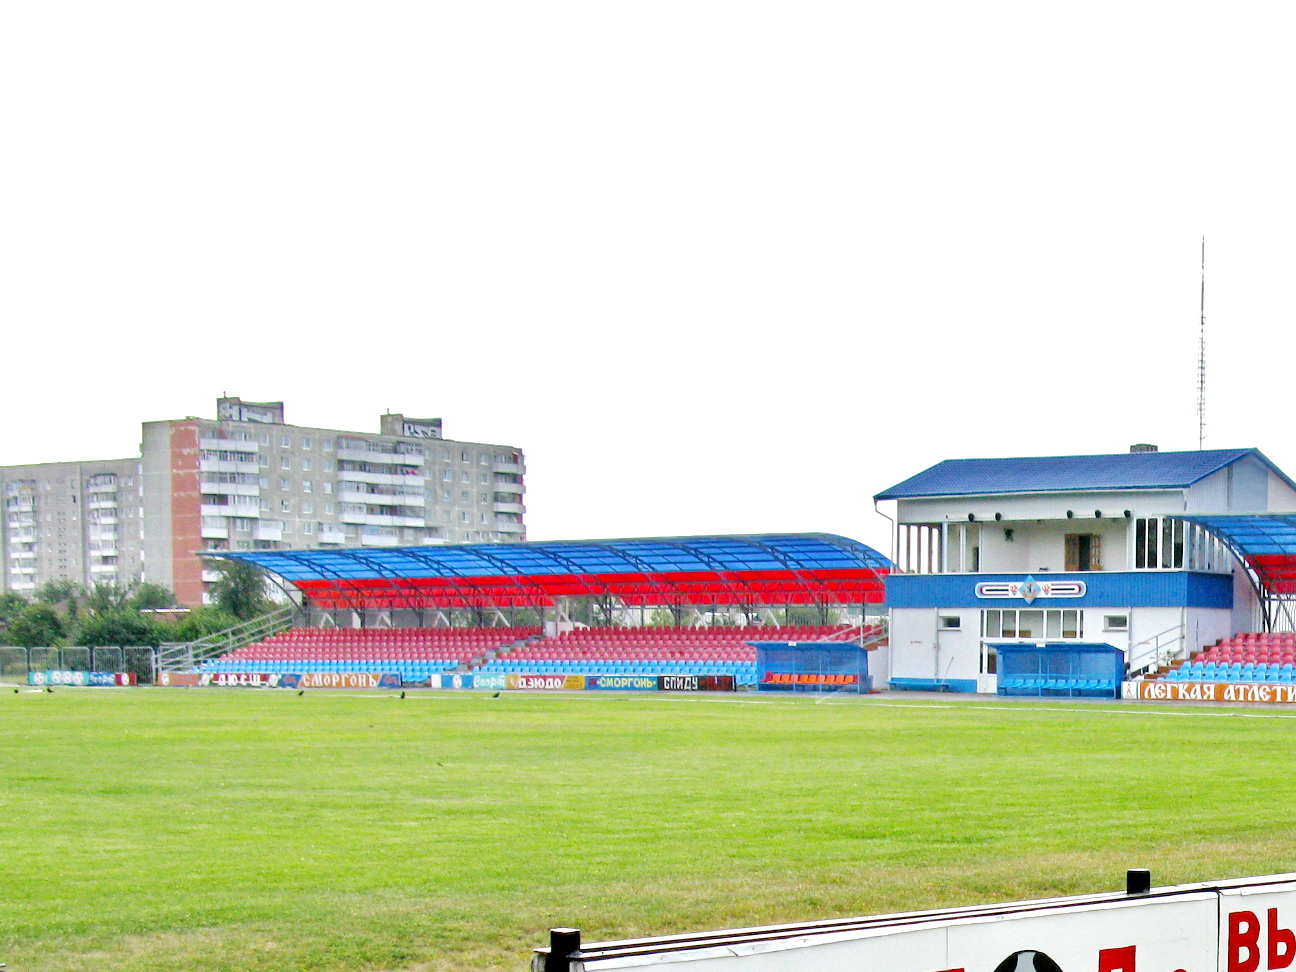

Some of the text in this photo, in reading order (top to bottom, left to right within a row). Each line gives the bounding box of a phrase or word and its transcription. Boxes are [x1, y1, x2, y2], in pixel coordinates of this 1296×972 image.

[519, 677, 562, 690] ДЗЮДО
[599, 677, 655, 689] СМОРГОНЬ
[664, 677, 699, 690] СПИДУ
[1144, 683, 1216, 702] ЛЕГКАЯ
